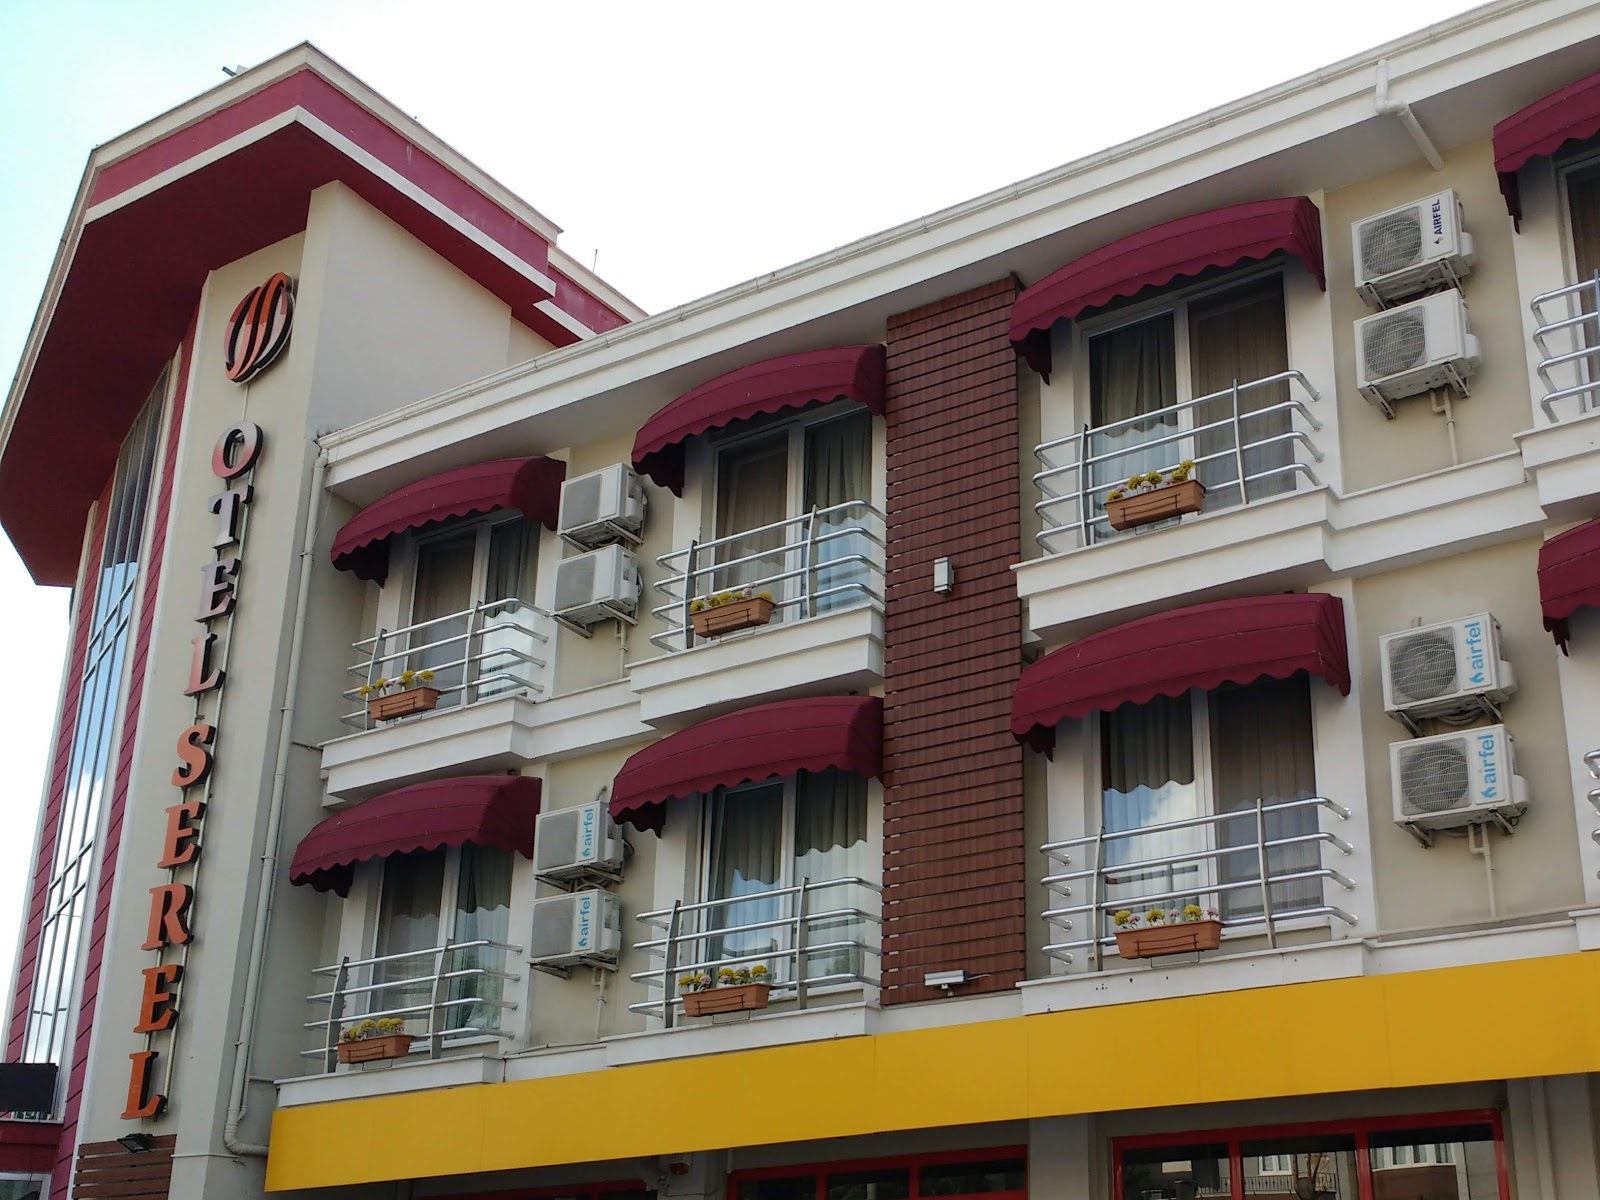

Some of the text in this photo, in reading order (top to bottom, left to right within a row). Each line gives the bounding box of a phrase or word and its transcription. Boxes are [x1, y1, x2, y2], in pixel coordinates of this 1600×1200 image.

[1432, 199, 1442, 235] AIRFEL
[1464, 621, 1483, 670] airfel
[120, 421, 263, 1119] OTEL SEREL
[1478, 734, 1497, 784] airfel
[583, 808, 594, 846] airfel
[579, 897, 591, 937] airfel
